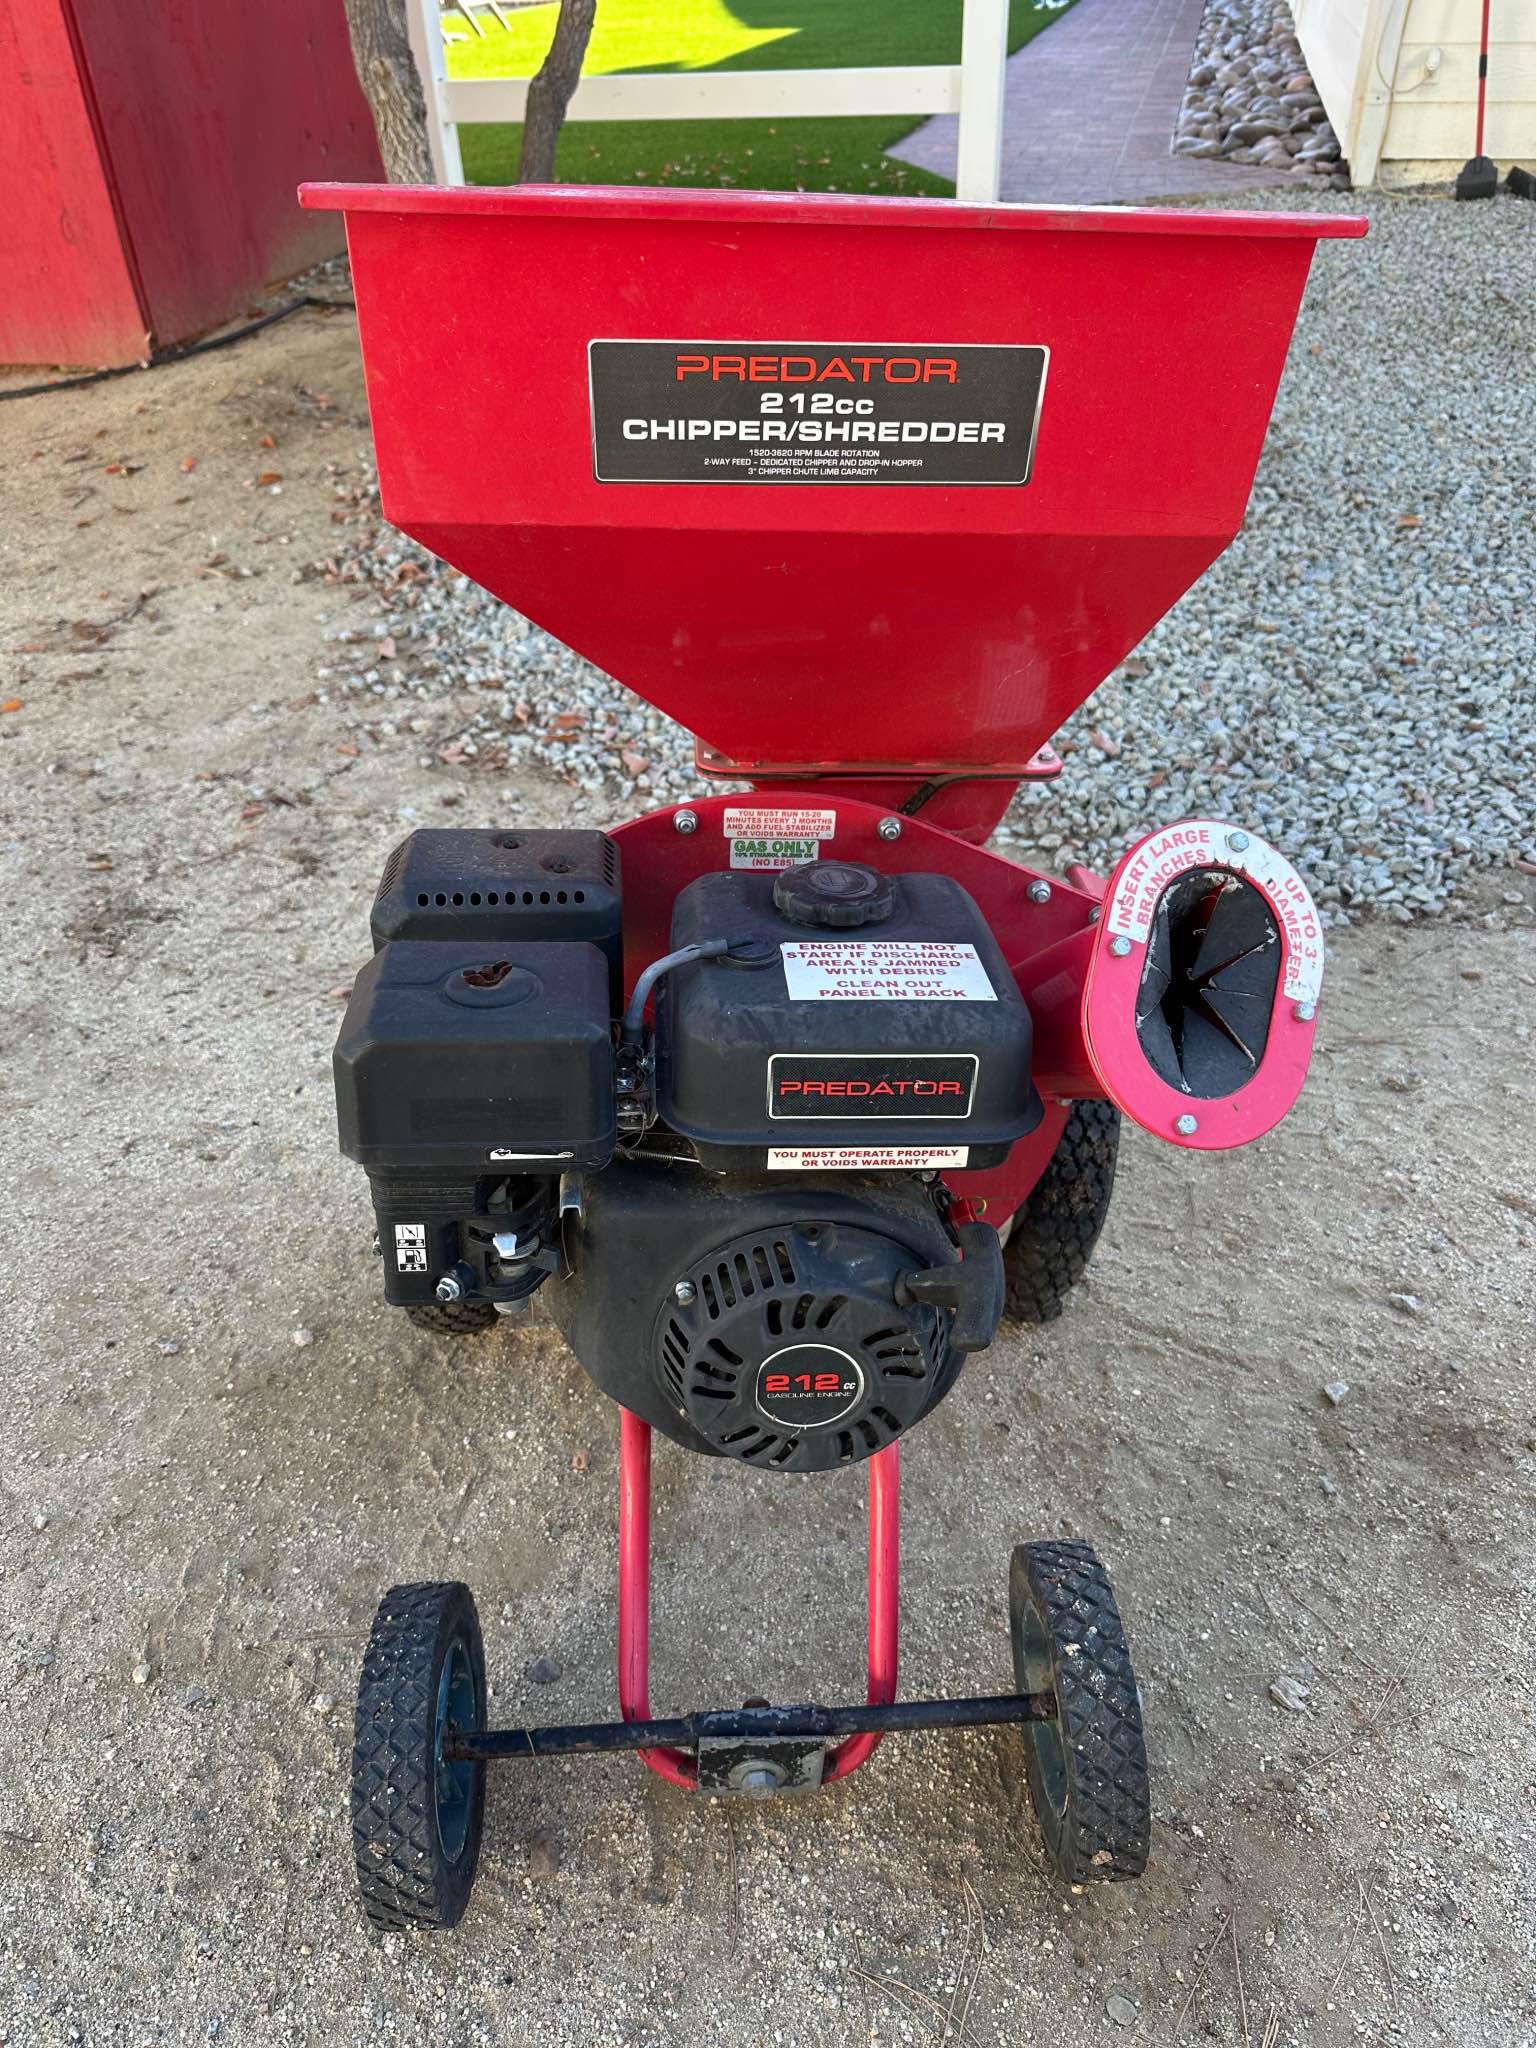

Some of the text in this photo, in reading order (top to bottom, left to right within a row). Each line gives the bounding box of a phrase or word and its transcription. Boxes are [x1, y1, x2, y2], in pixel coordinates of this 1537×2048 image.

[676, 355, 957, 383] PREDATOR
[760, 393, 875, 415] 212cc
[622, 419, 1005, 443] CHIPPER/SHREDDER
[749, 449, 880, 458] 1520-3620 RPM BLADE ROTATION
[704, 458, 730, 466] 2-WAY
[732, 458, 751, 466] FEED
[760, 458, 804, 467] DEDICATED
[805, 459, 838, 467] CHIPPER
[839, 459, 857, 467] AND
[859, 459, 890, 467] DROP-IN
[891, 459, 923, 467] HOPPER
[748, 467, 878, 476] 3" CHIPPER CHUTE LIMB CAPACITY
[734, 840, 816, 853] GAS ONLY
[752, 858, 795, 867] (NO E85)
[1117, 829, 1210, 929] INSERT LARGE
[1136, 848, 1208, 926] BRANCHES
[1283, 877, 1306, 904] UP
[1301, 911, 1317, 940] TO
[1266, 878, 1302, 982] DIAMETER
[872, 943, 917, 951] WILL
[786, 951, 976, 960] START IF DISCHARGE
[806, 959, 961, 967] AREA IS JAMMED
[826, 968, 947, 976] WITH DEBRIS
[836, 980, 944, 988] CLEAN OUT
[819, 989, 968, 997] PANEL IN BACK
[780, 1081, 961, 1097] PREDATOR
[773, 1149, 960, 1159] YOU MUST OPERATE PROPERLY
[801, 1158, 929, 1167] OR VOIDS WARRANTY
[765, 1373, 840, 1392] 212
